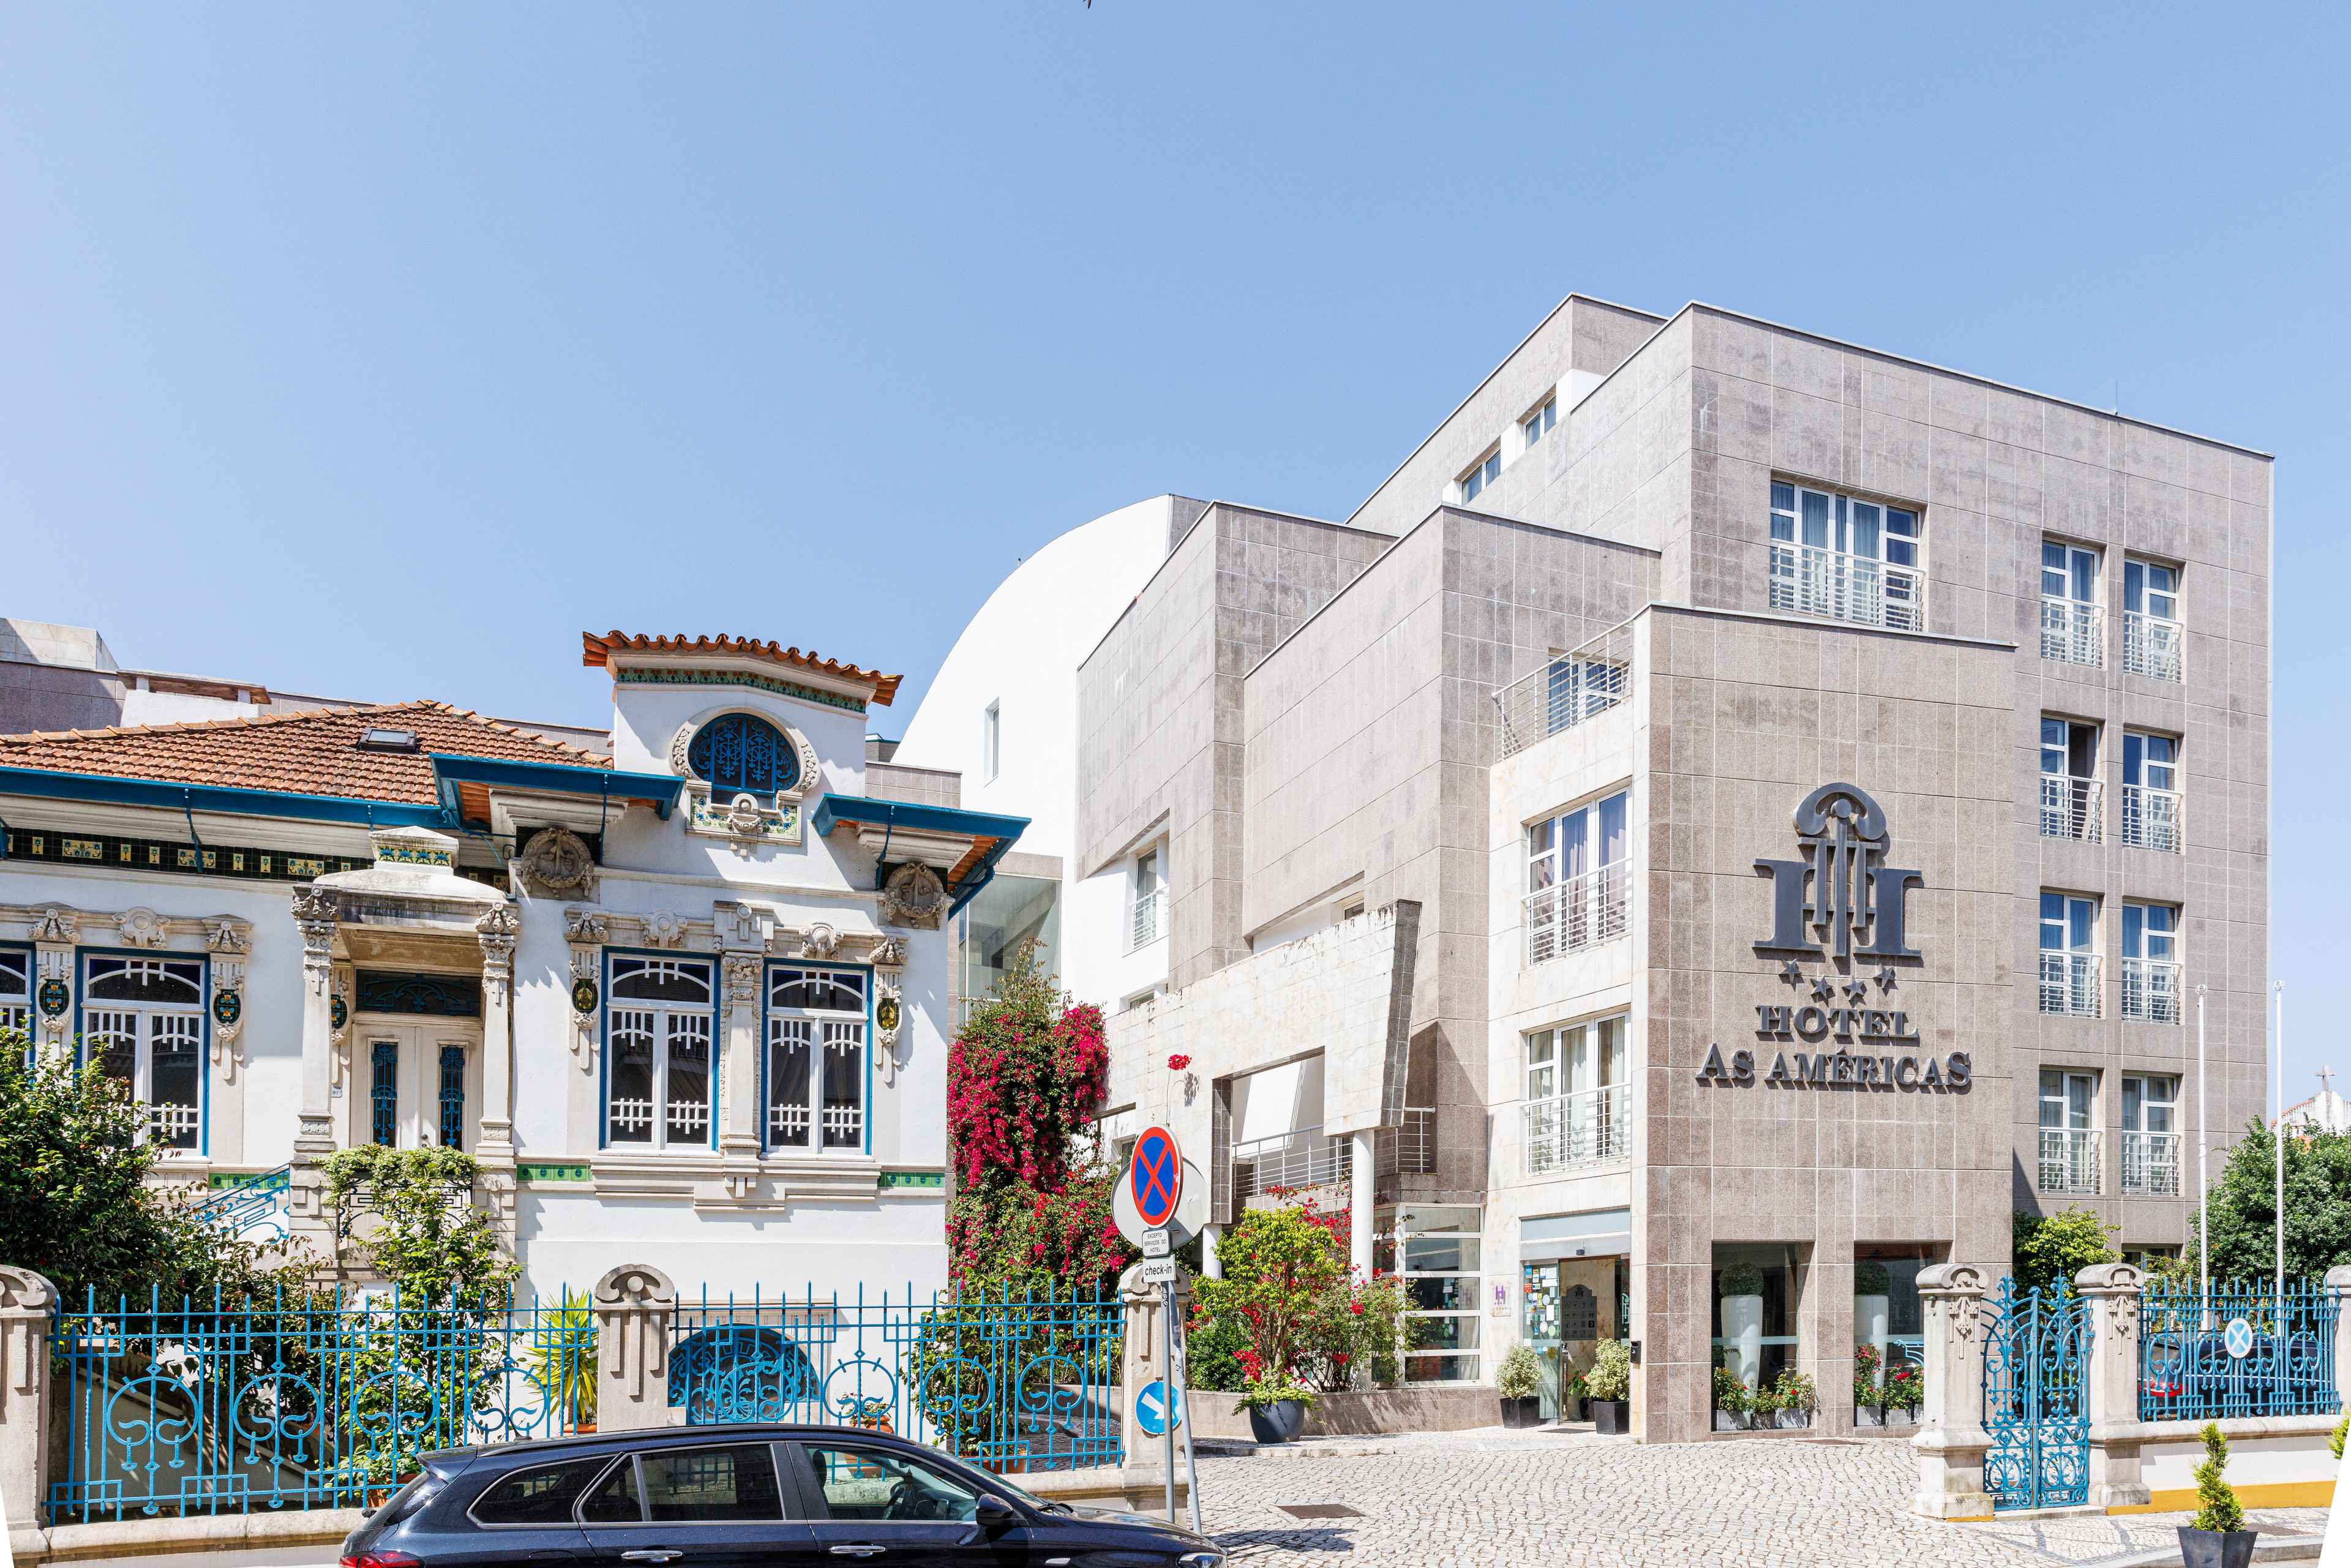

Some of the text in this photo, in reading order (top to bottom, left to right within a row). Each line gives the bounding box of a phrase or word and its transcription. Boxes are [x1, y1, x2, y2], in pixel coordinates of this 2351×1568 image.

[1755, 1005, 1919, 1038] HOTEL
[1695, 1043, 1971, 1087] AS AMÉRICAS
[1145, 1263, 1172, 1275] check-in
